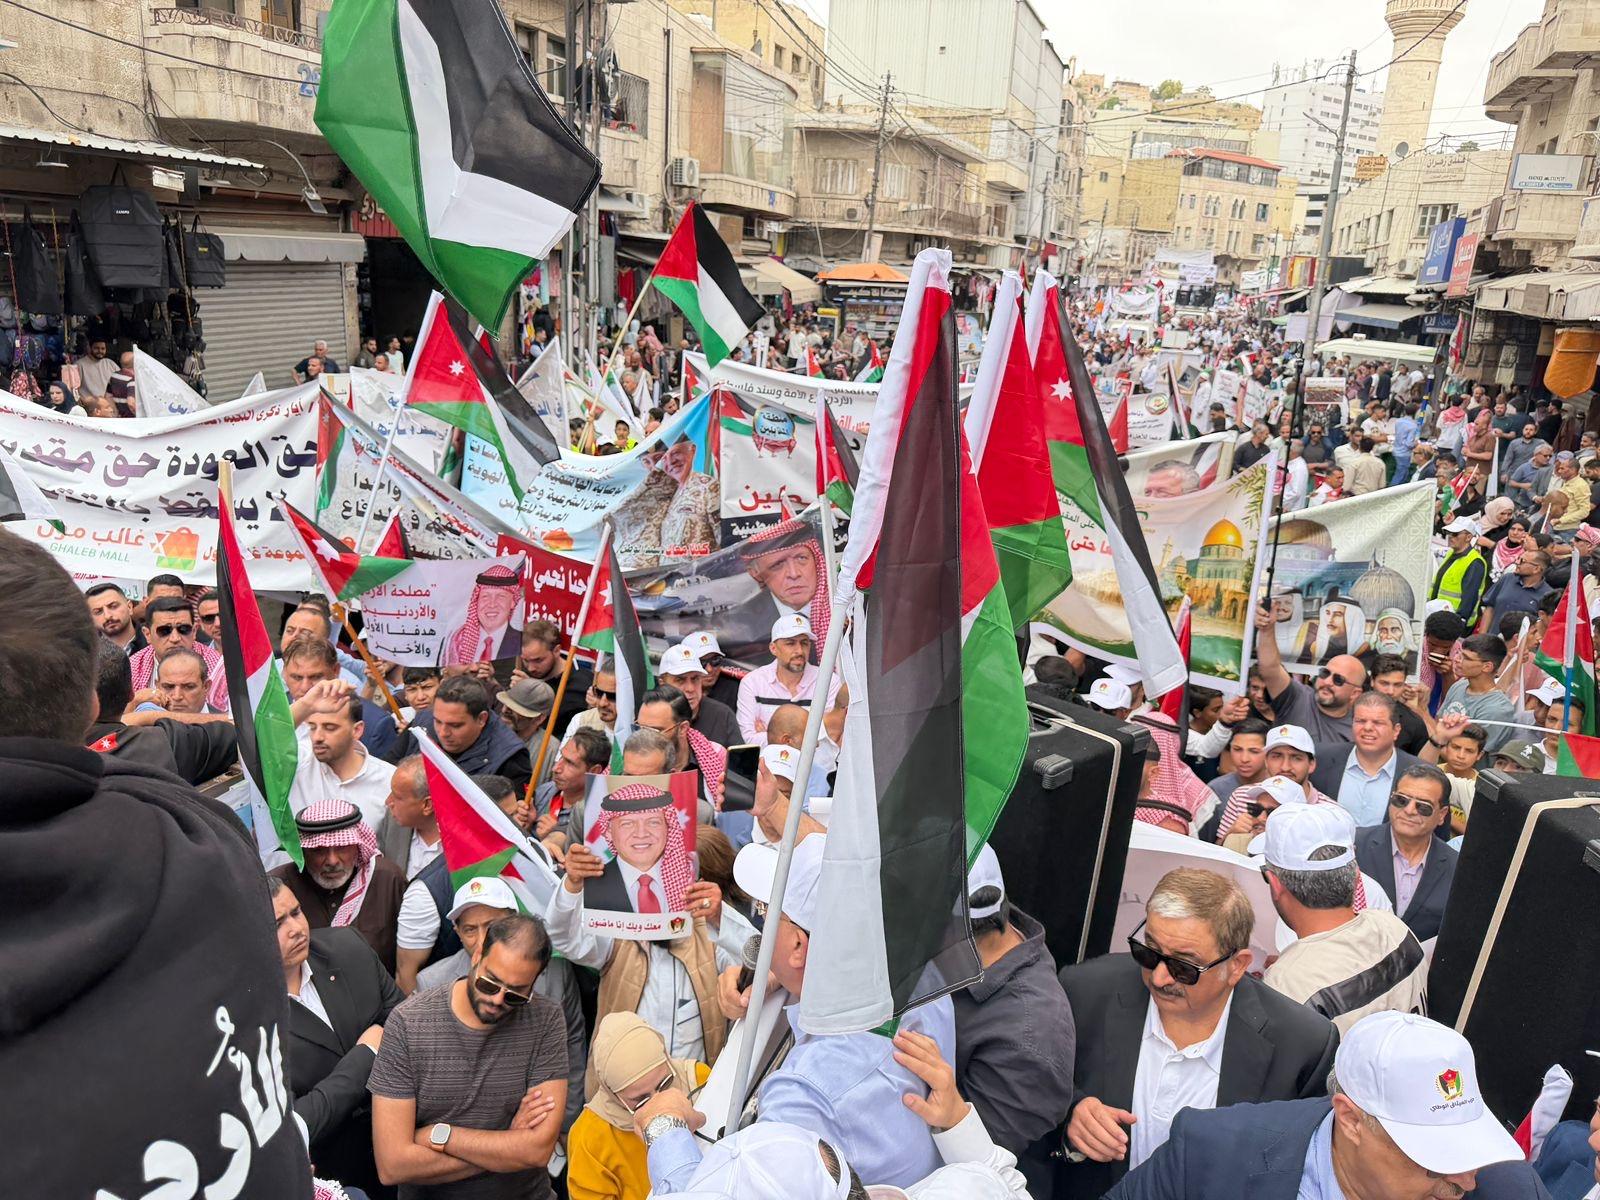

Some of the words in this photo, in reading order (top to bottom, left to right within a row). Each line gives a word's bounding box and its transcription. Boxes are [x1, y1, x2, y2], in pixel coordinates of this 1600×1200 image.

[756, 385, 782, 400] وسند
[103, 444, 160, 487] حق
[92, 527, 145, 547] غالب
[49, 542, 97, 558] GHALEB
[99, 550, 130, 563] MALL
[386, 623, 437, 637] هدفنا
